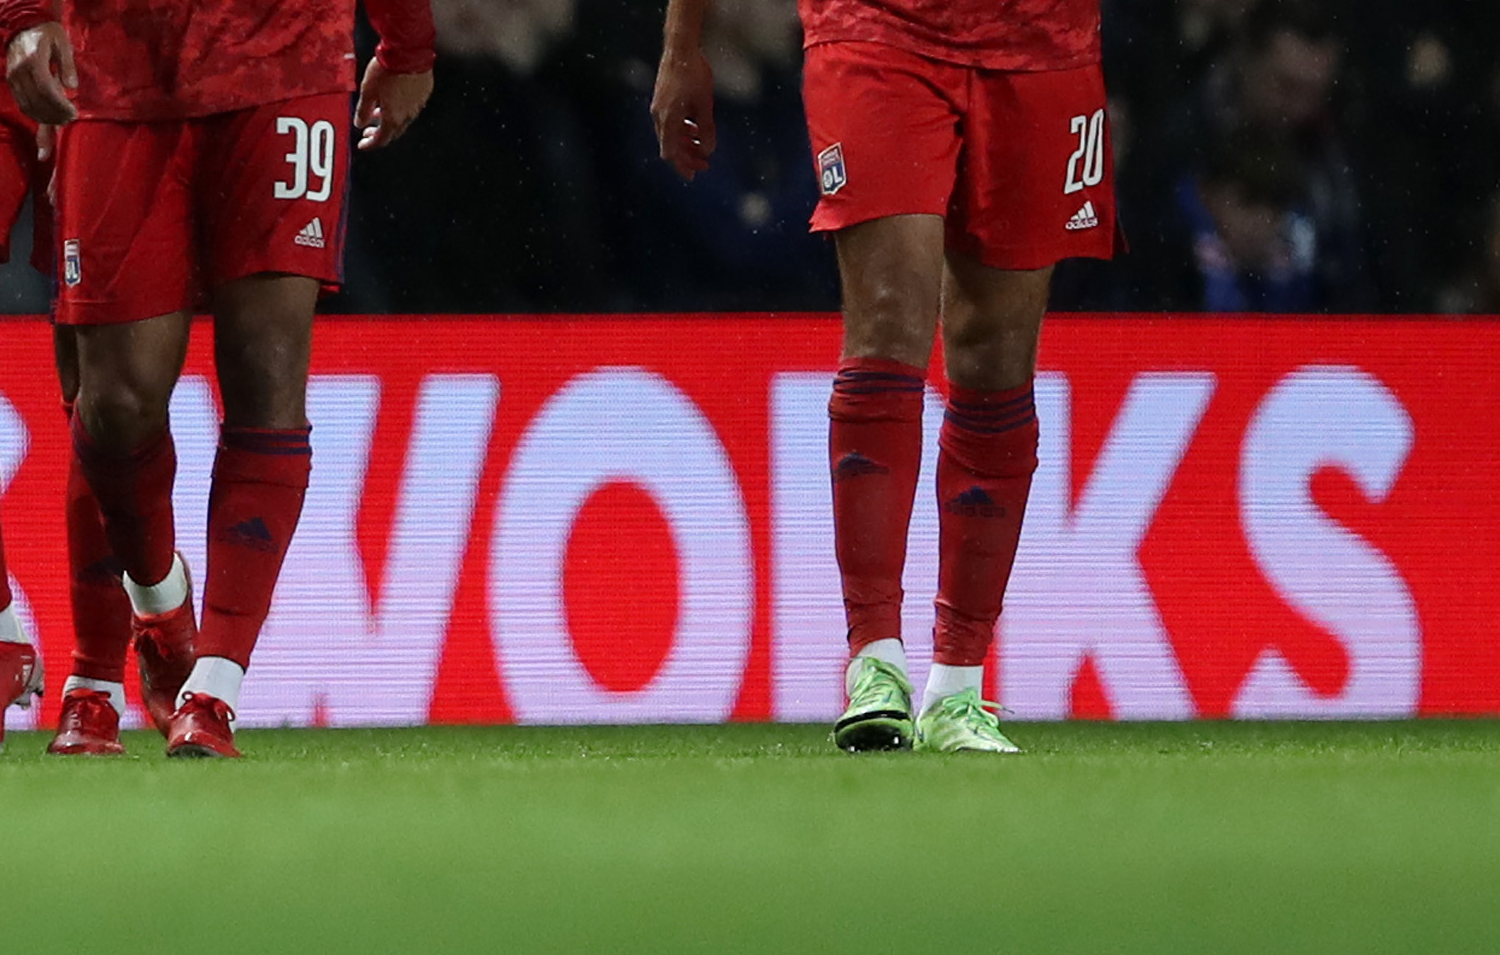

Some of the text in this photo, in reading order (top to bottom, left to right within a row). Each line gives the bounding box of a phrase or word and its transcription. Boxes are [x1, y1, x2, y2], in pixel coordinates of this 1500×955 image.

[274, 117, 335, 202] 39
[1064, 108, 1104, 194] 20
[1065, 216, 1098, 230] adidas
